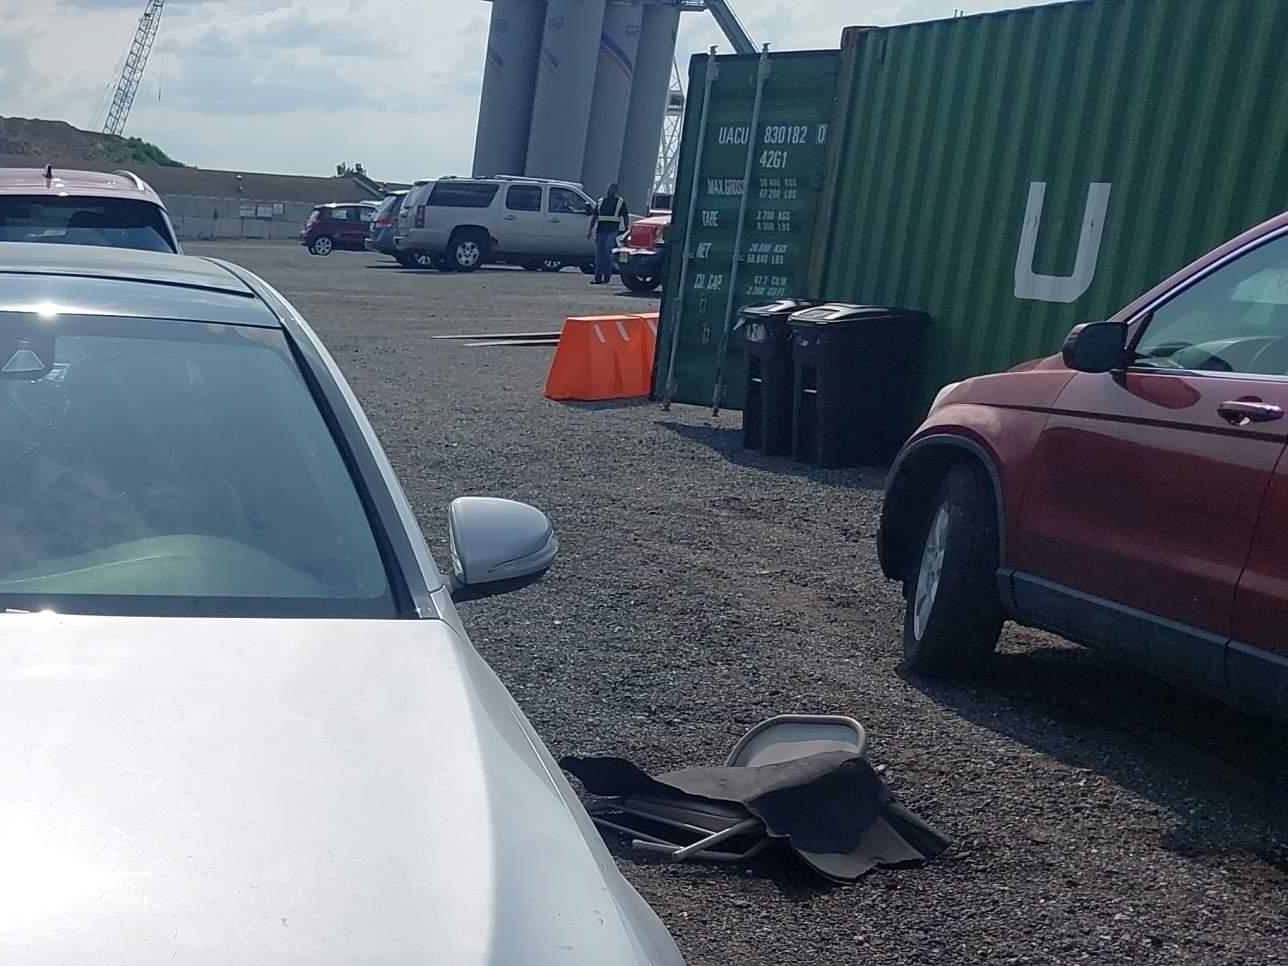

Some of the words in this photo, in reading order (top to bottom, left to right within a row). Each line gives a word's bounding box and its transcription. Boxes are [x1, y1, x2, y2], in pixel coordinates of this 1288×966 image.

[718, 126, 750, 145] UACU
[763, 125, 808, 144] 830182
[759, 150, 788, 169] 42G1
[696, 242, 712, 259] NET
[1014, 181, 1112, 303] U
